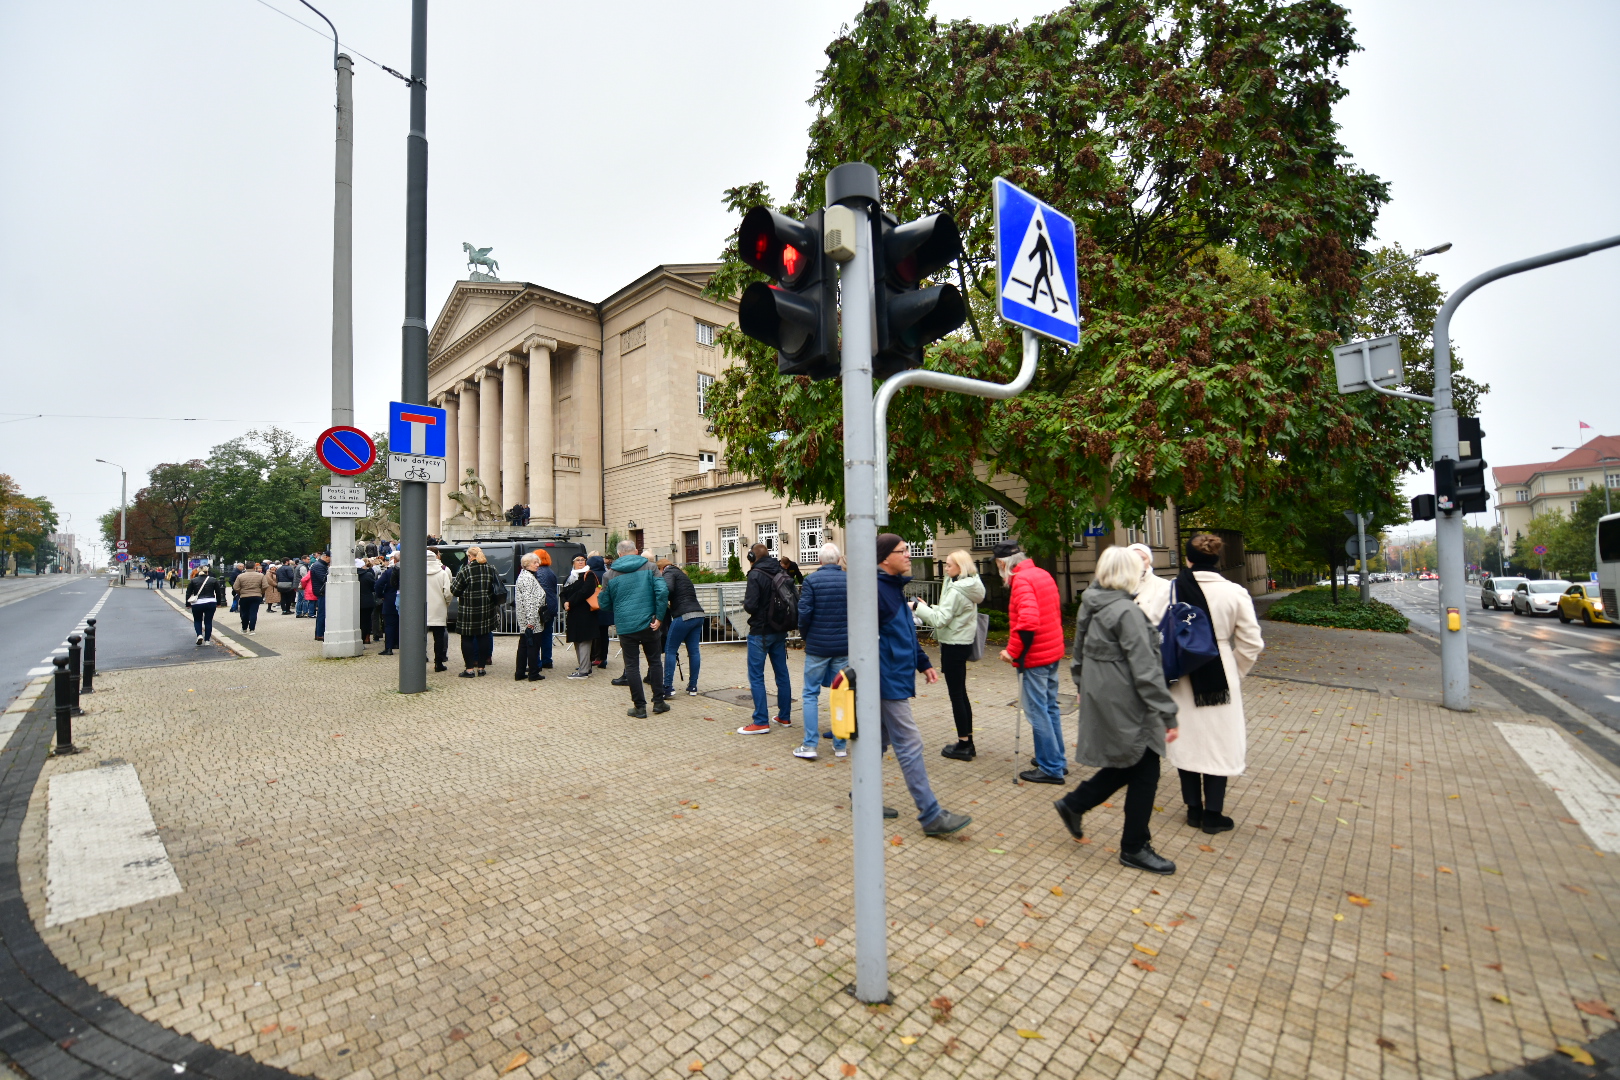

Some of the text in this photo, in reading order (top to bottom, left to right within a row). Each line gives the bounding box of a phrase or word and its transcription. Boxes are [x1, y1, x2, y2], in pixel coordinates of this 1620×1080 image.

[394, 455, 441, 466] Nie dotyczy
[179, 537, 187, 545] P
